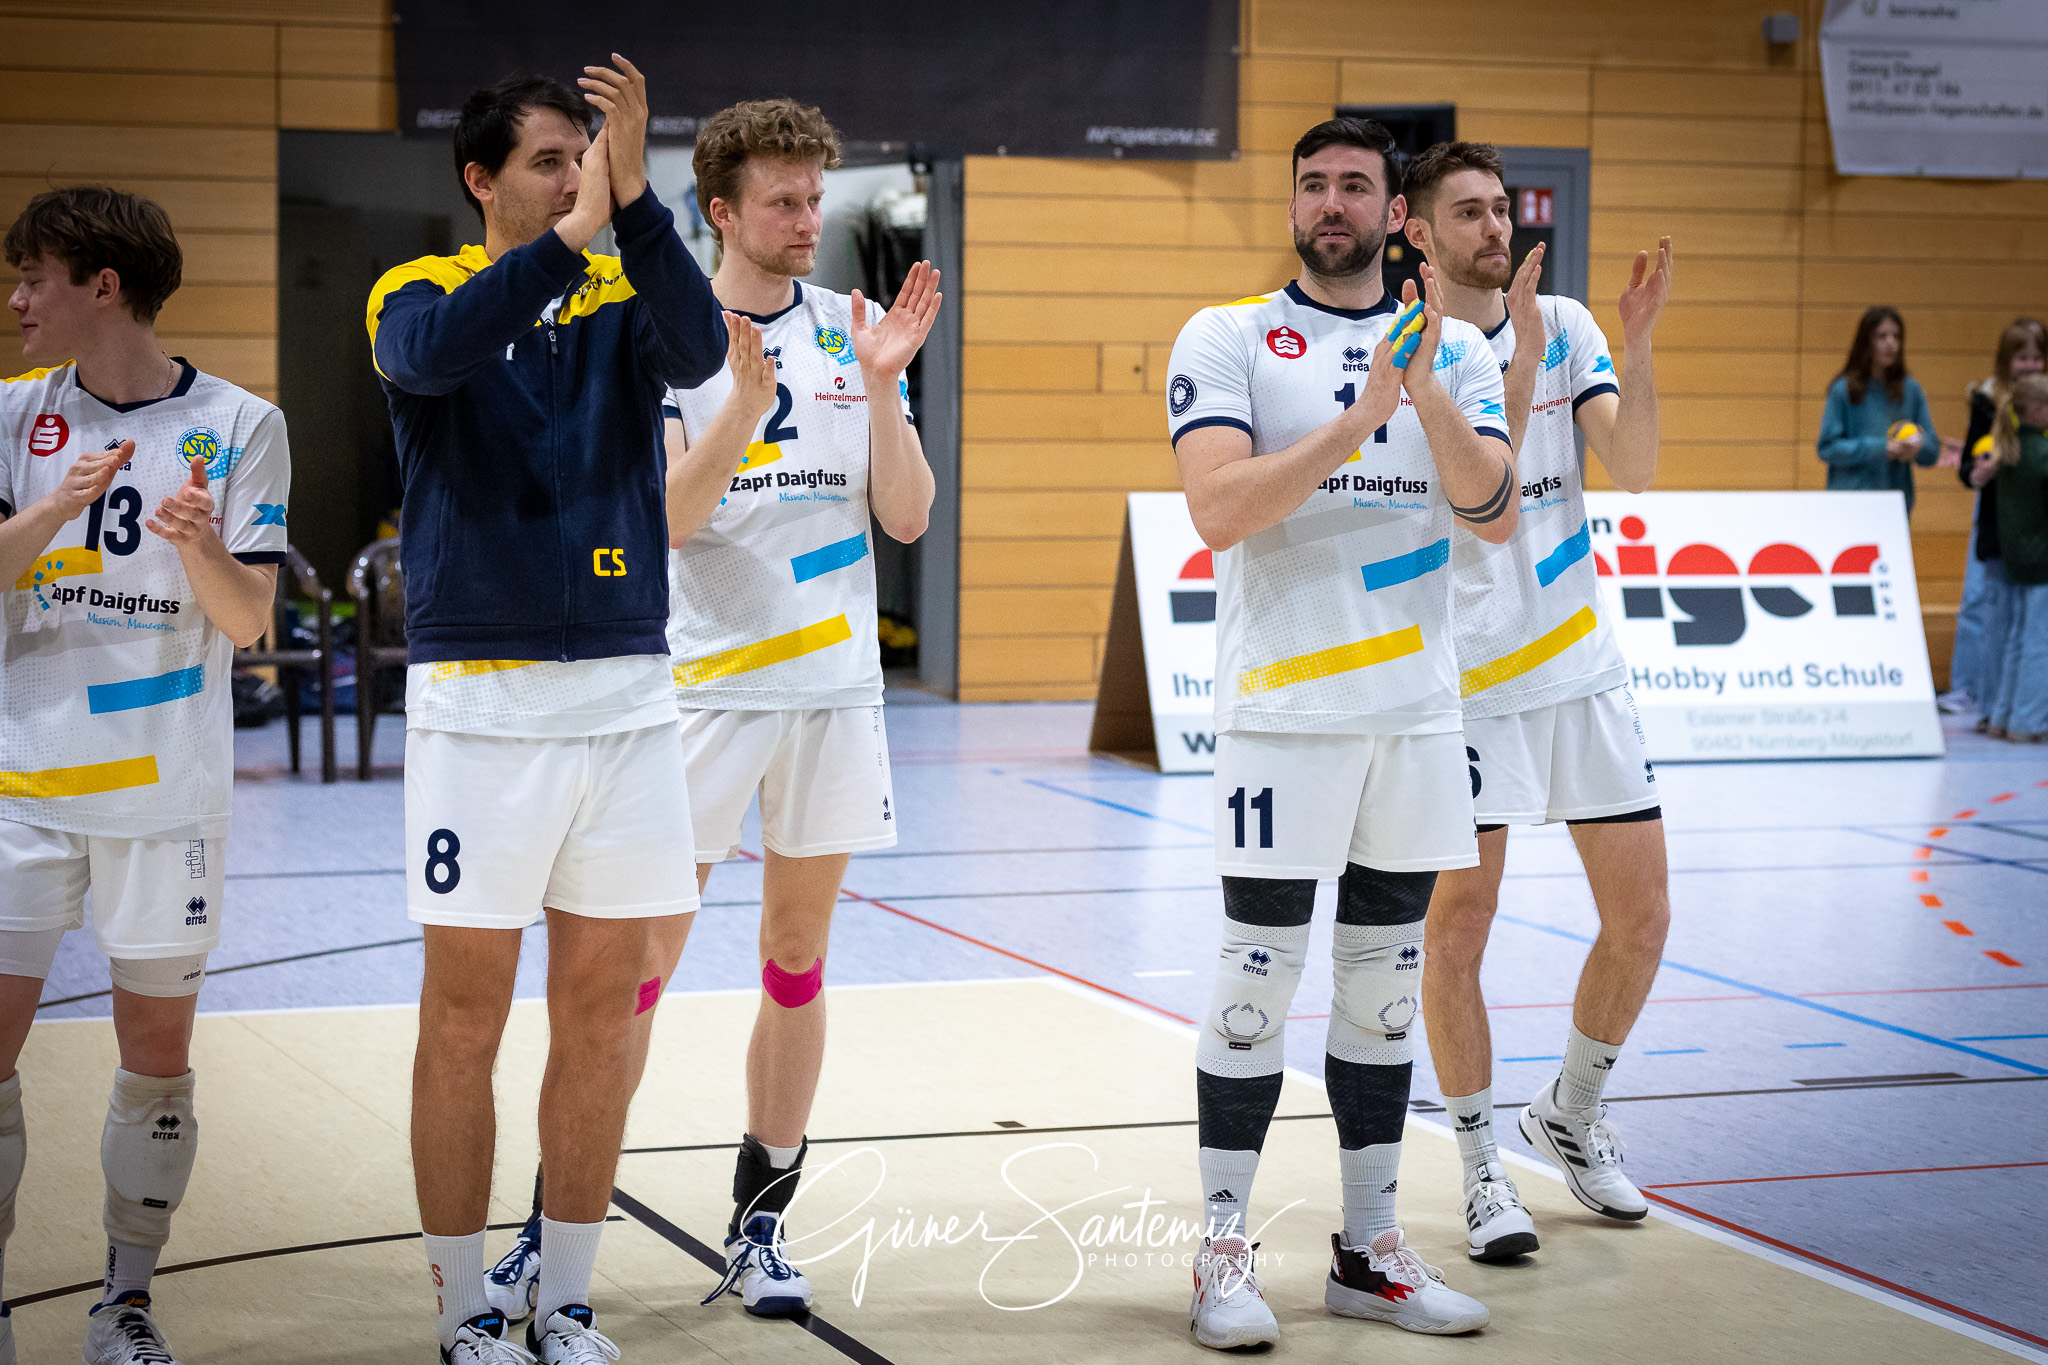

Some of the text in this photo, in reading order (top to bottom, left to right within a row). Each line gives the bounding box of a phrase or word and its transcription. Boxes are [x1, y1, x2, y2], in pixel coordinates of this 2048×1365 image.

[814, 392, 868, 403] Heinzelmann
[776, 469, 847, 488] Daigfuss
[1317, 474, 1428, 496] apf Daigfuss
[84, 485, 143, 557] 13
[593, 548, 627, 577] CS
[88, 588, 181, 615] Daigfuss
[1631, 662, 1904, 695] Hobby und Schule
[1227, 786, 1274, 849] 11
[424, 828, 461, 895] 8
[1454, 1119, 1490, 1133] erima
